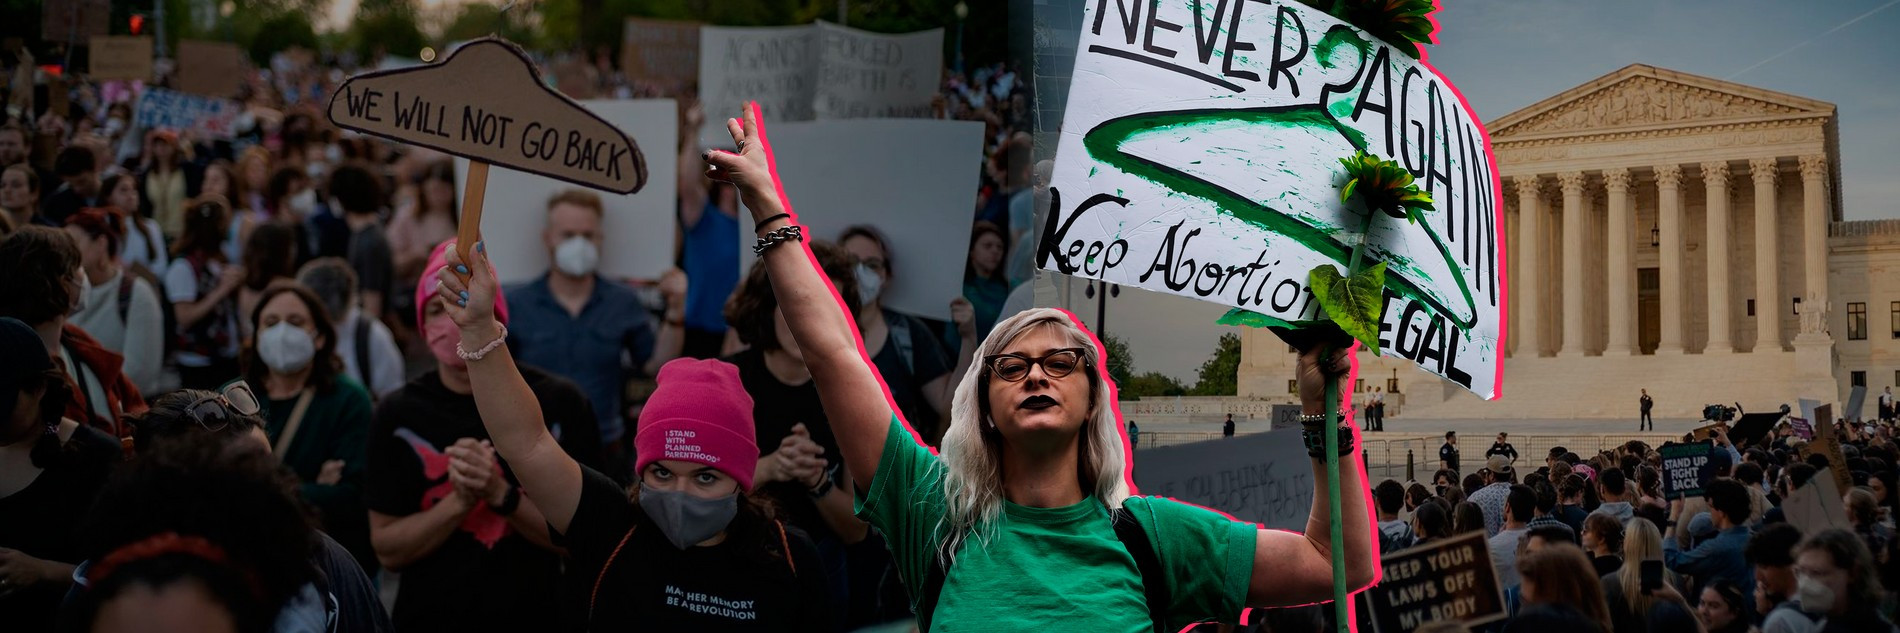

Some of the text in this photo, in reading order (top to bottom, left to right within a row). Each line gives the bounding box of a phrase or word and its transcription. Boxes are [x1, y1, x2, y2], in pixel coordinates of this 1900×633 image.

[1092, 0, 1309, 98] NEVER
[347, 86, 627, 181] WE WILL NOT GO BACK
[1351, 45, 1496, 306] AGAIN
[1037, 187, 1323, 320] Keep Abortion
[1378, 286, 1472, 389] EGAL
[664, 444, 701, 452] PLANNED
[669, 430, 696, 438] STAND
[1217, 460, 1275, 494] THINK
[1664, 456, 1708, 470] STAND UP
[1671, 467, 1699, 479] FIGHT
[1672, 478, 1700, 491] BACK
[1427, 544, 1474, 573] YOUR
[666, 596, 679, 606] BE
[681, 600, 688, 608] A
[686, 592, 707, 602] HER
[1388, 569, 1475, 608] LAWS OFF
[1398, 595, 1477, 631] MY BODY
